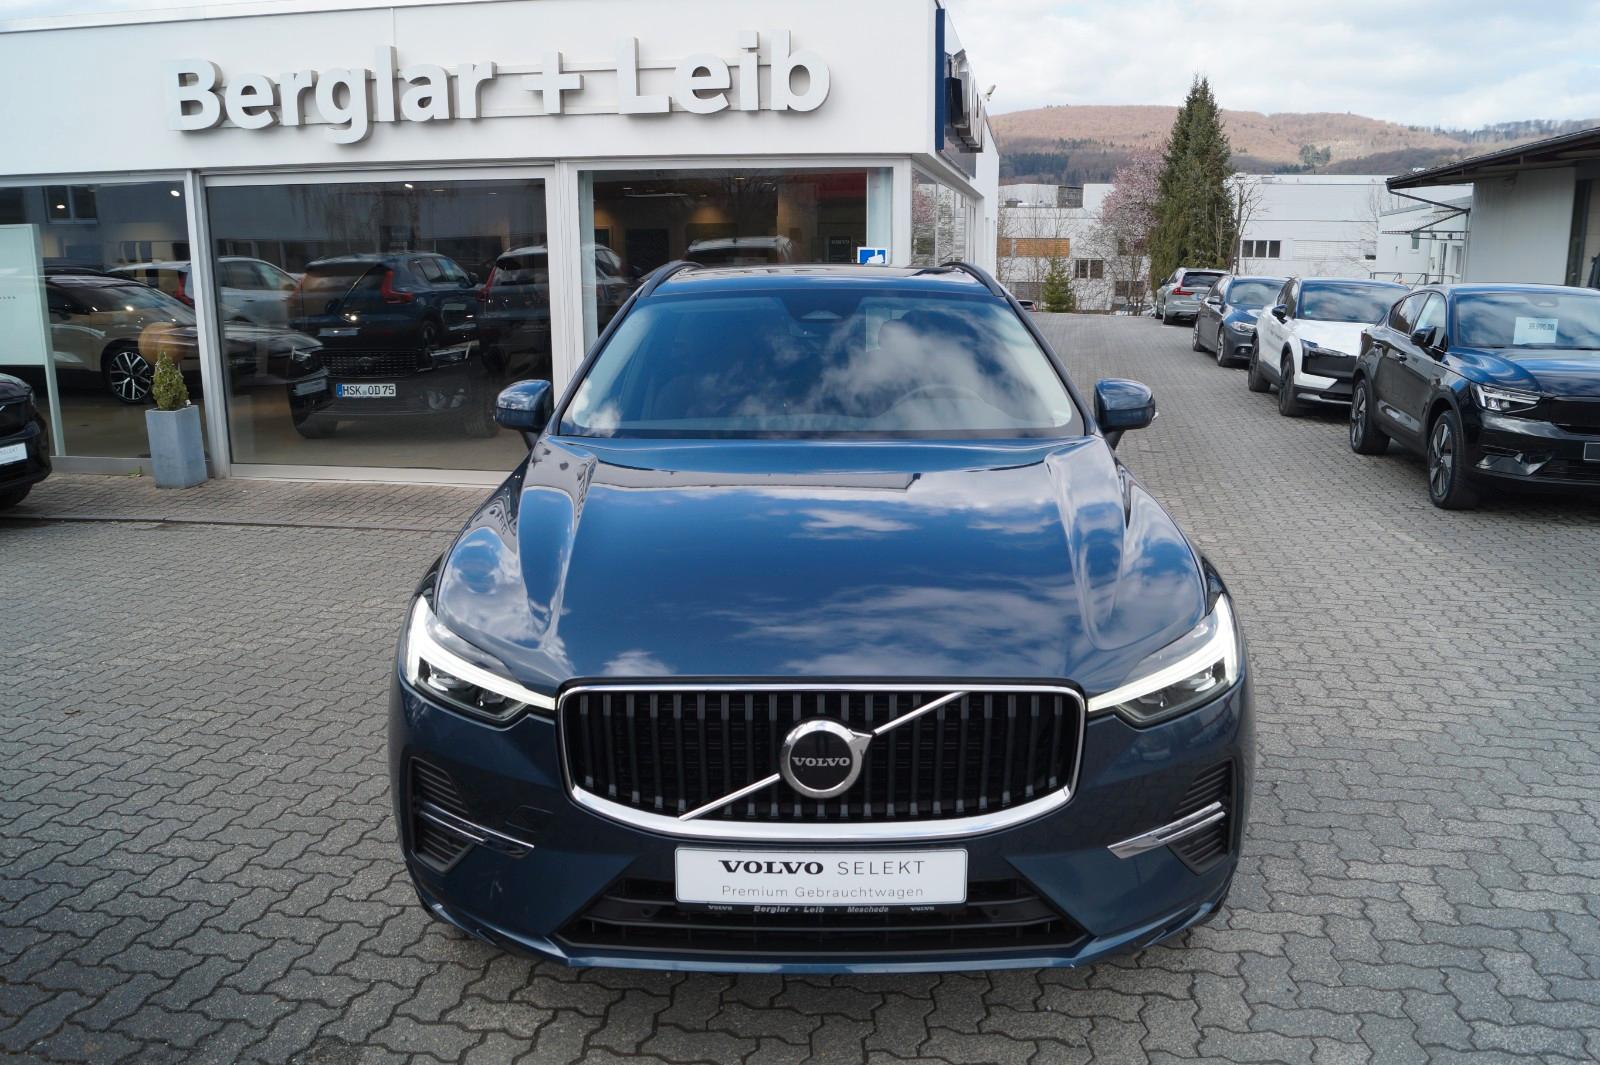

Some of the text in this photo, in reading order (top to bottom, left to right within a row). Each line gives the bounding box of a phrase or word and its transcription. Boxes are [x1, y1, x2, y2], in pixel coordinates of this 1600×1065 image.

[169, 30, 831, 145] Berglar + Leib
[343, 385, 361, 395] HSK
[382, 385, 394, 395] 75
[792, 757, 850, 767] VOLVO
[719, 860, 925, 875] VOLVO SELEKT
[722, 885, 924, 901] Premium Gebrauchtwagen
[753, 906, 790, 914] Berglar
